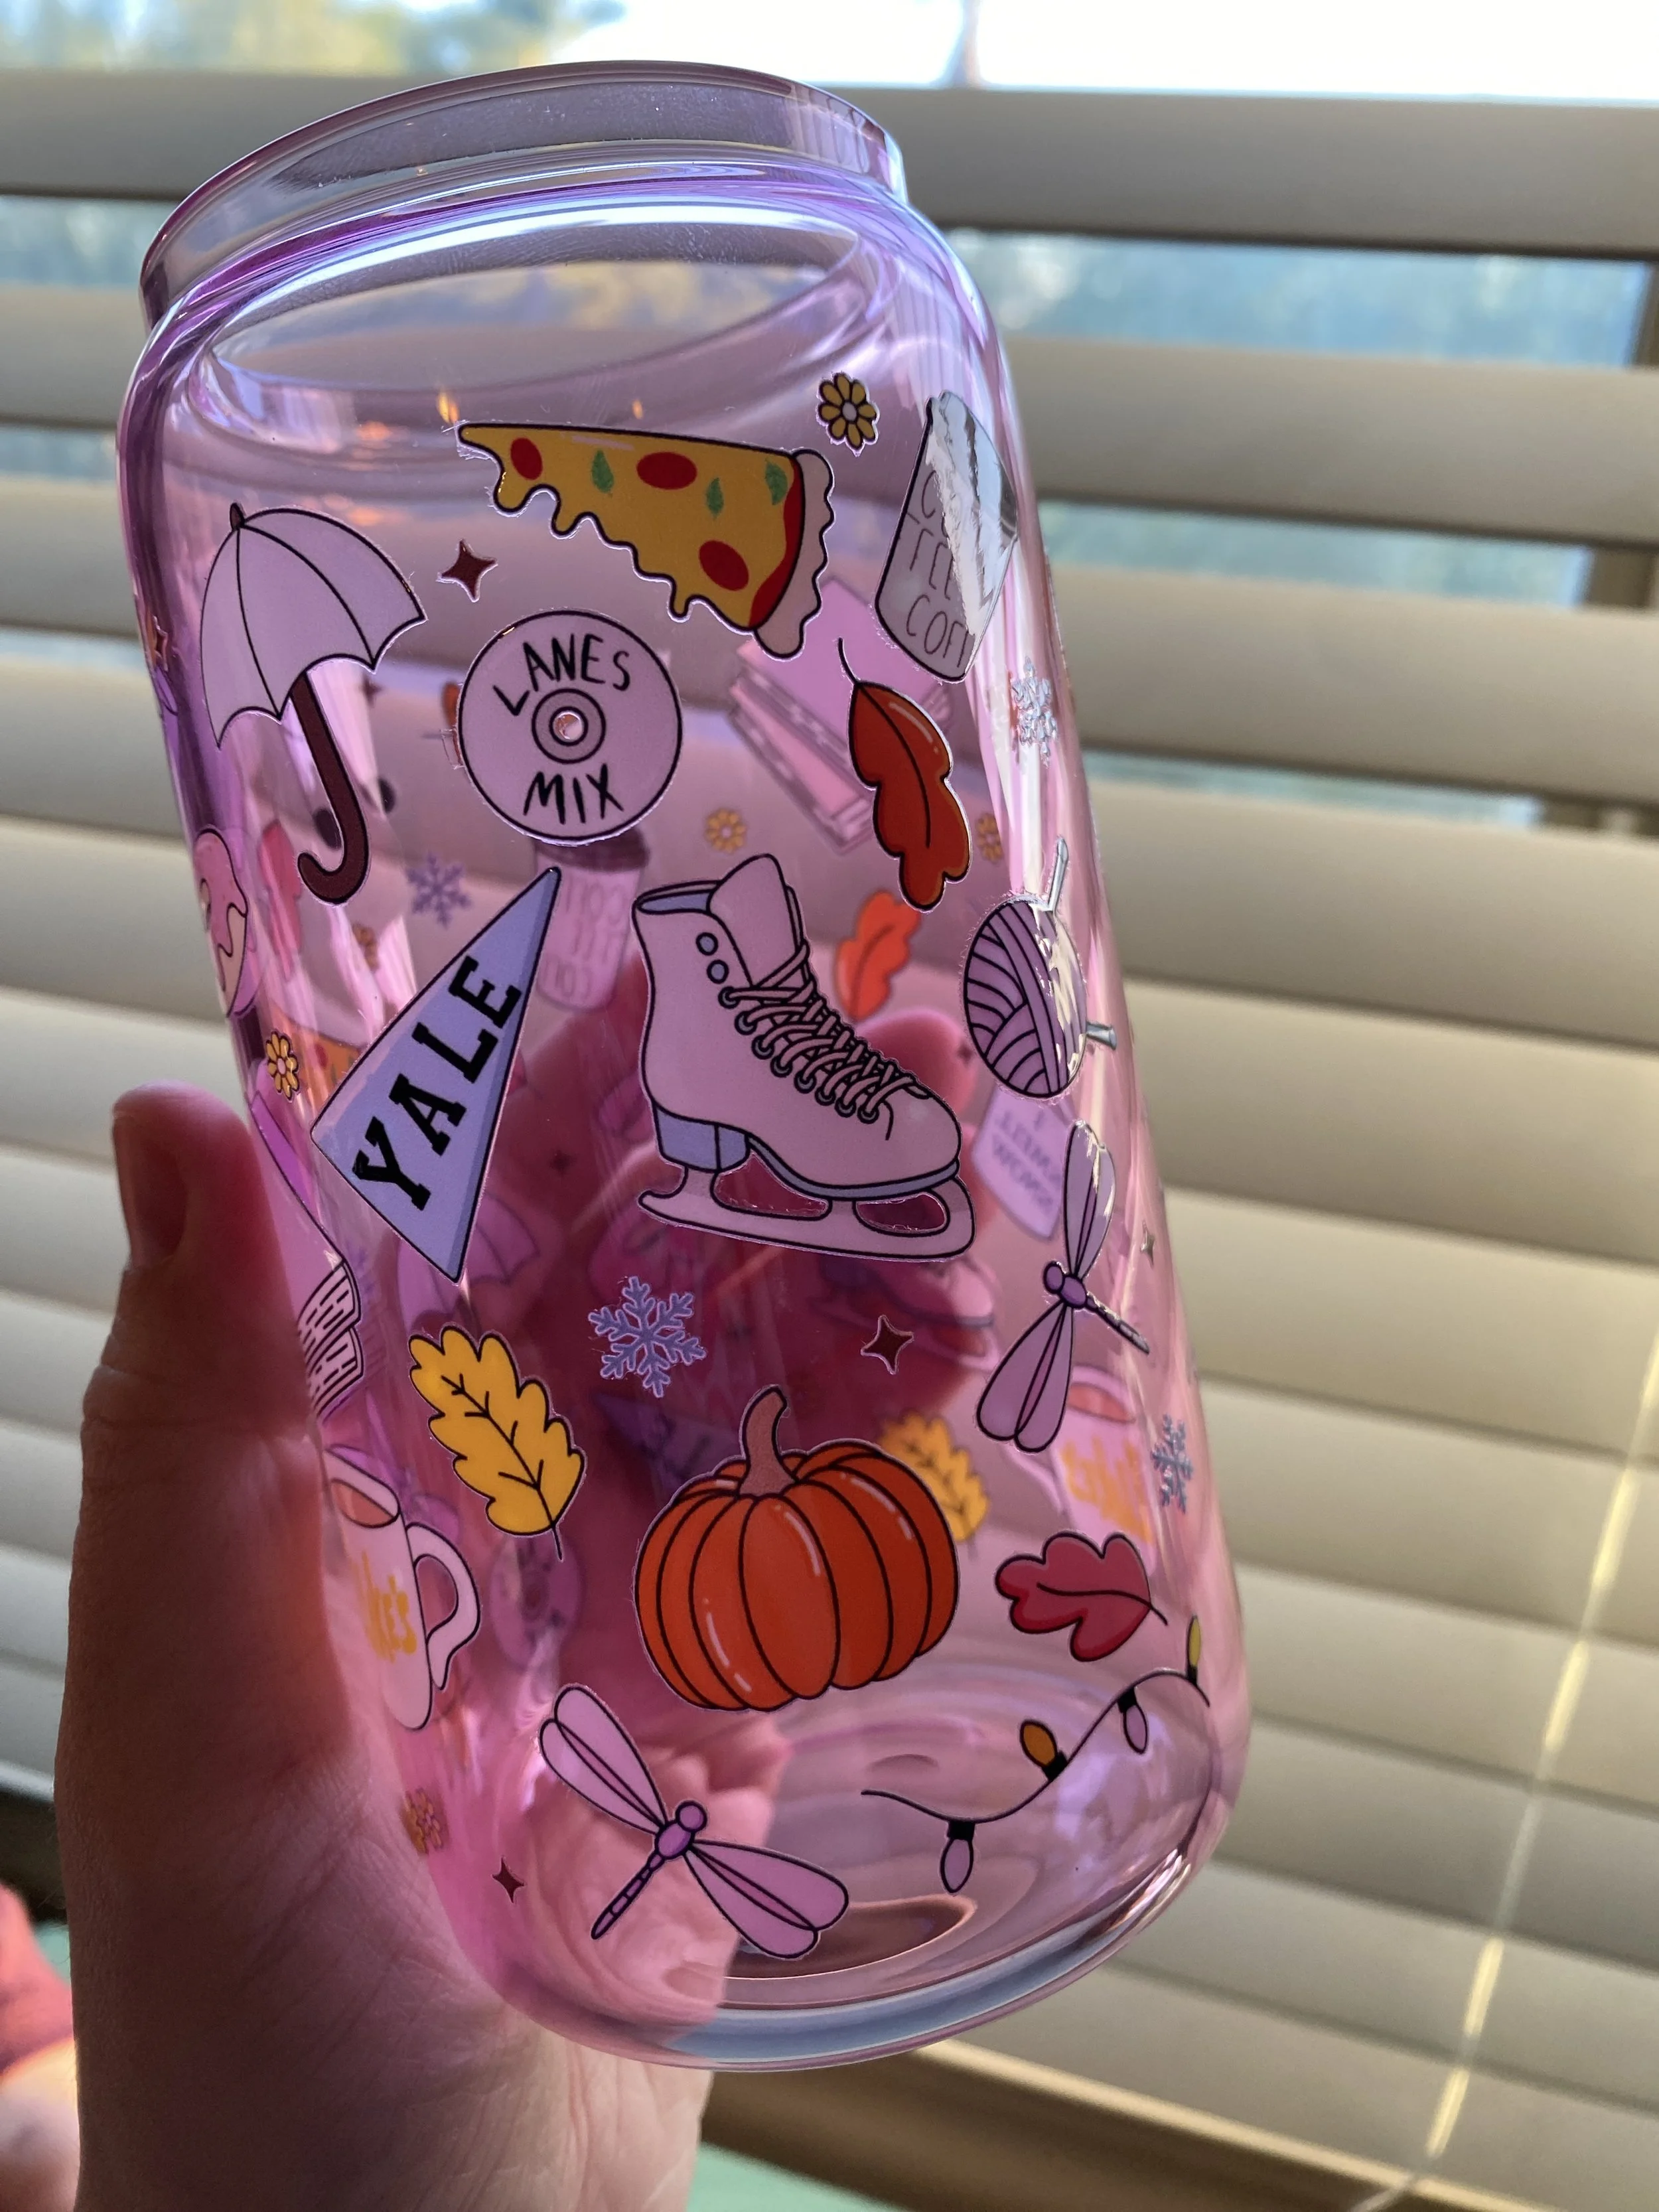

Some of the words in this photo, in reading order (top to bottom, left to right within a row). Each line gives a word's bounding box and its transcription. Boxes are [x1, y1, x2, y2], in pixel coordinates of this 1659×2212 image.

[492, 633, 631, 717] LANES
[522, 763, 624, 825] MIX
[352, 956, 522, 1211] YALE
